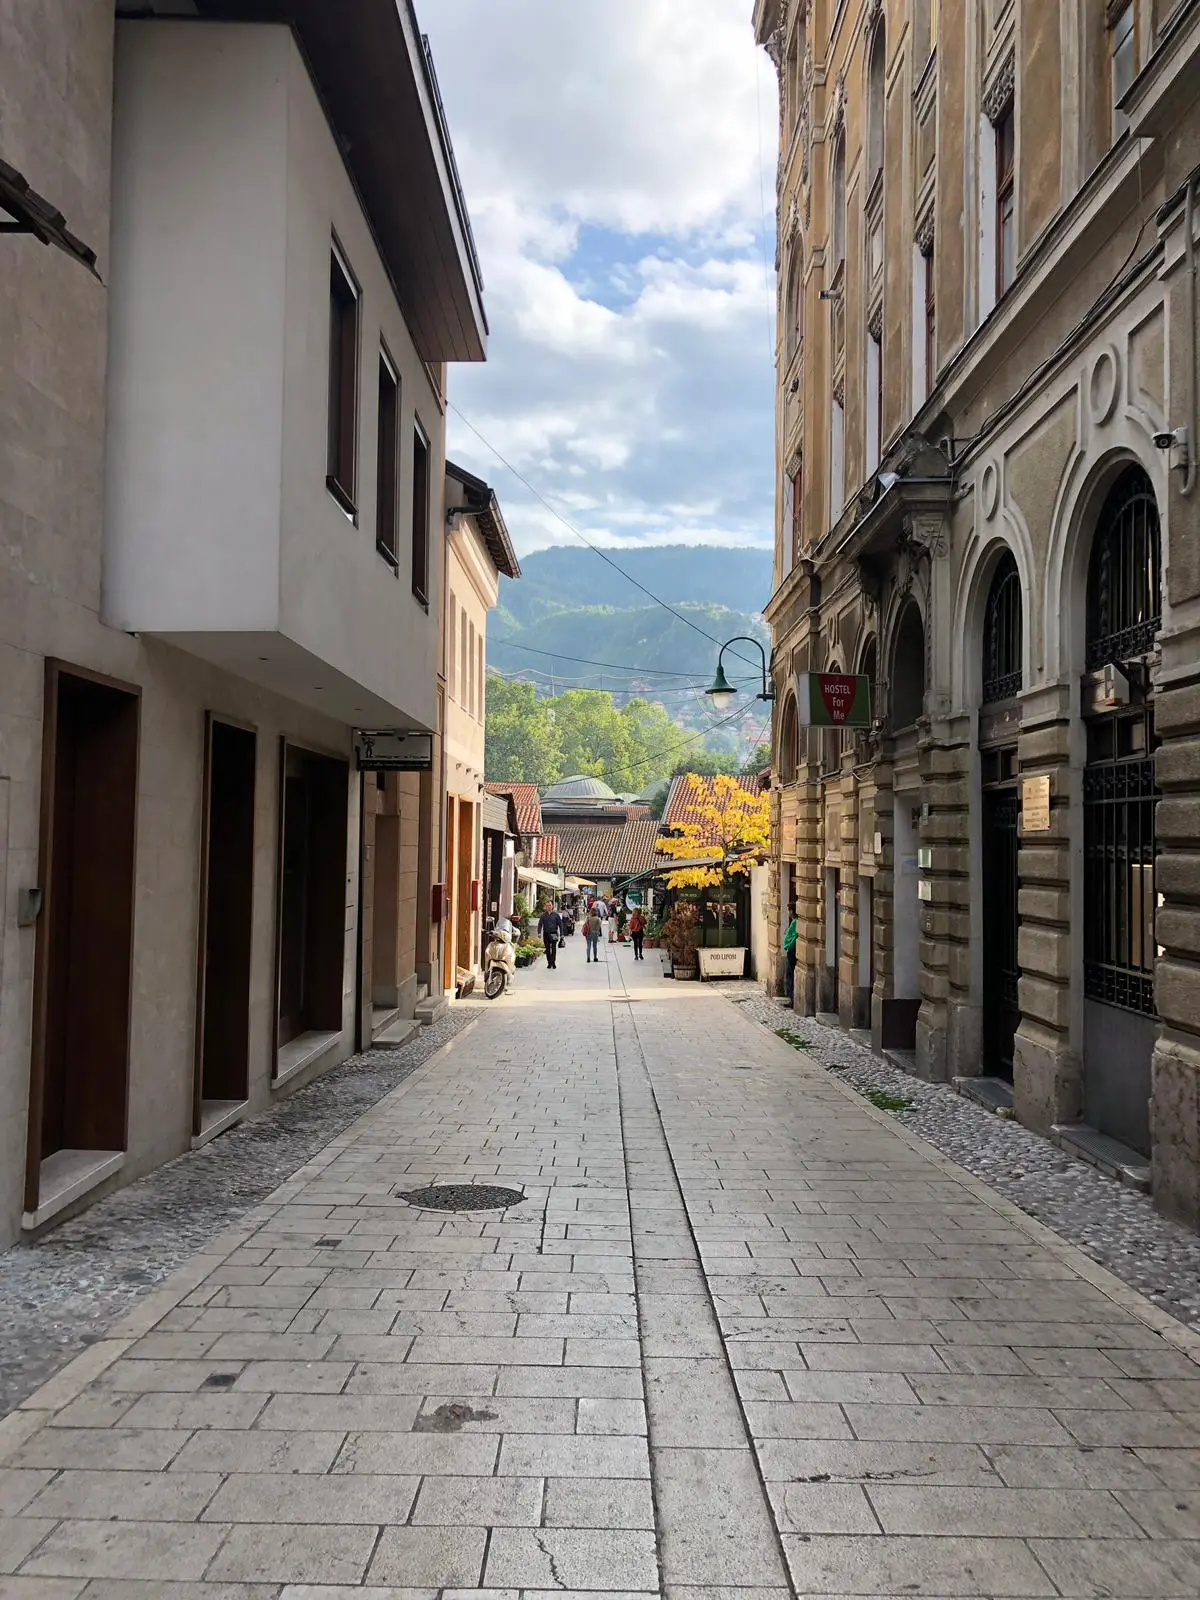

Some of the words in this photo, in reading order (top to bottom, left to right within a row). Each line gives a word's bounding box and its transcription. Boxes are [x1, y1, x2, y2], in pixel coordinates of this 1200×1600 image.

[824, 684, 851, 694] HOSTEL
[832, 697, 844, 707] For
[833, 711, 845, 720] Me
